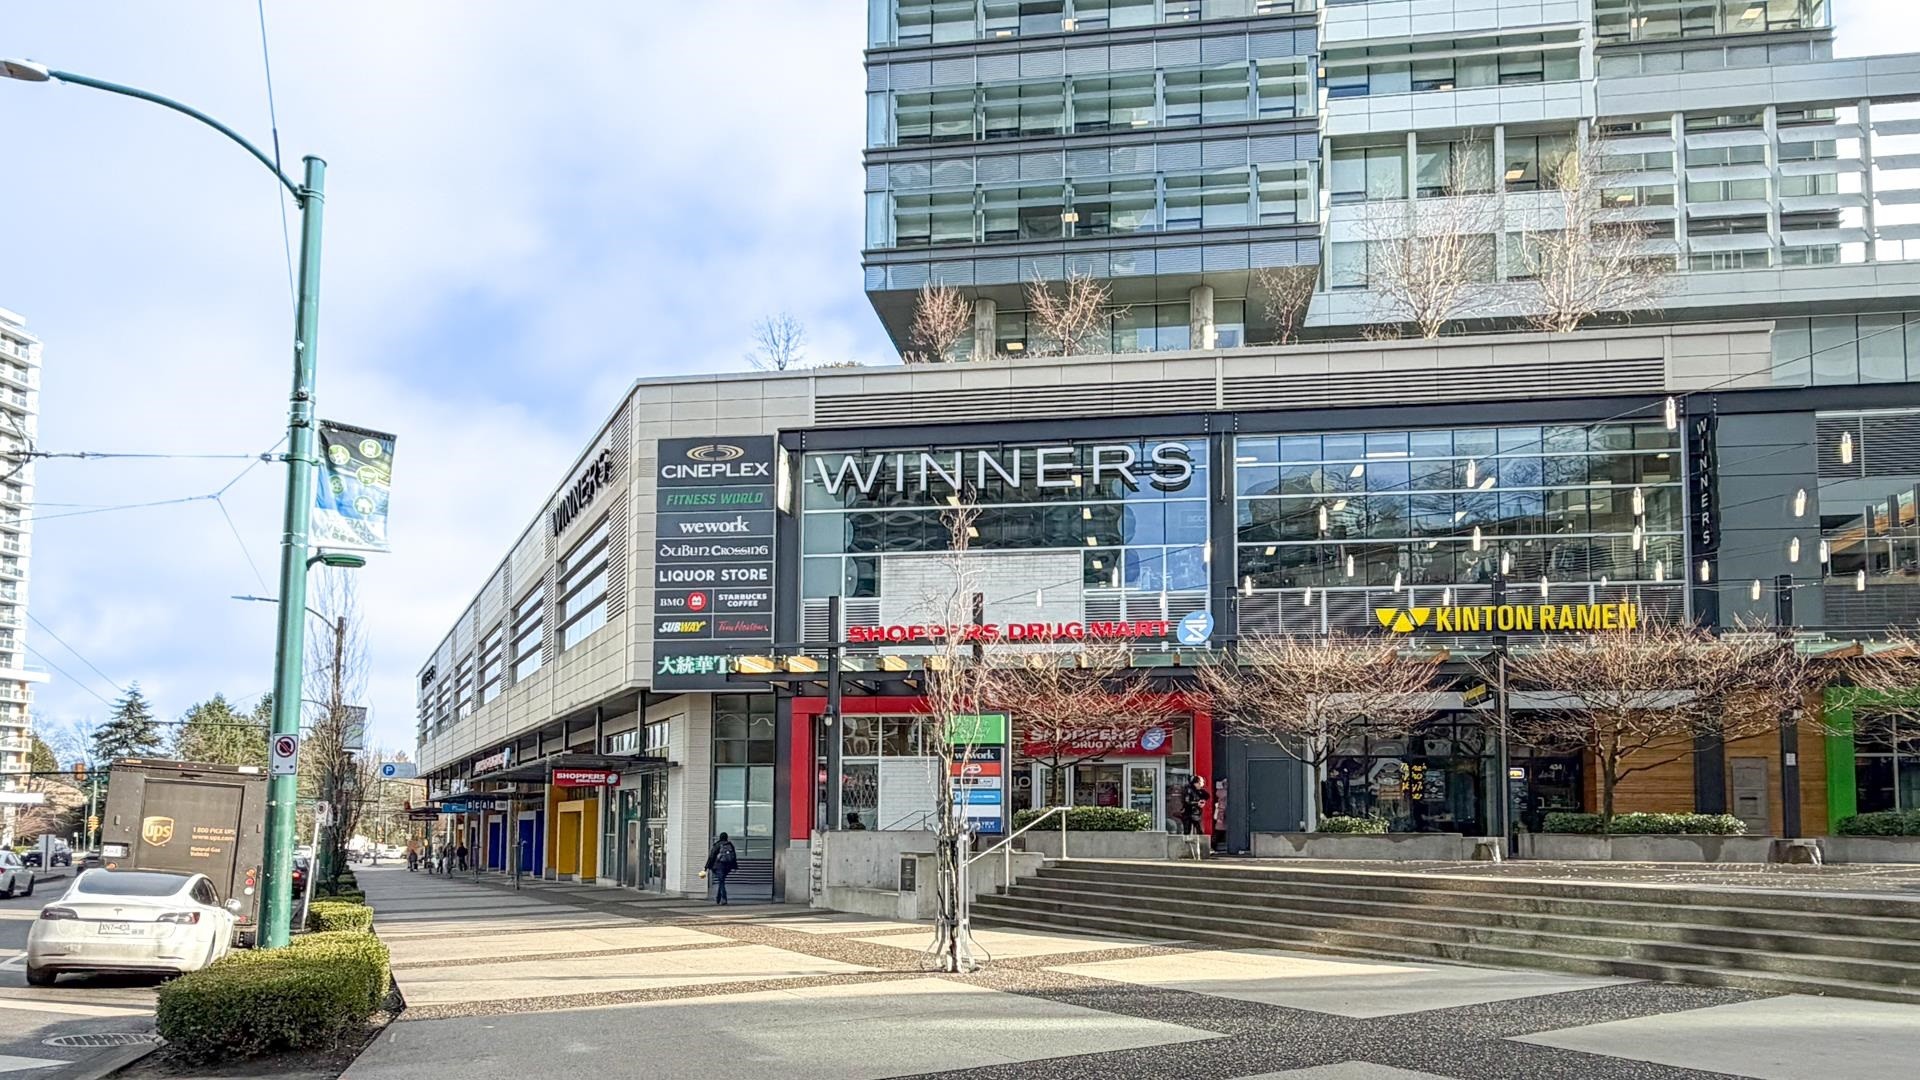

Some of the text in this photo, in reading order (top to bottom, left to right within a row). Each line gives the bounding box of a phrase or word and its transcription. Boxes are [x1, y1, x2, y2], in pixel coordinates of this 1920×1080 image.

[661, 462, 769, 478] CINEPLEX
[814, 442, 1192, 495] WINNERS
[1697, 418, 1711, 545] WINNERS
[553, 448, 612, 537] WINNERS
[666, 492, 764, 506] FITNESS WORLD
[679, 515, 750, 533] wework
[659, 568, 768, 582] LIQUOR STORE
[660, 598, 685, 606] BMO
[718, 593, 767, 601] STARBUCKS
[1436, 603, 1636, 632] KINTON RAMEN
[658, 621, 706, 633] SUBWAY
[719, 620, 769, 632] Tim Hortons
[1008, 620, 1084, 641] DRUG
[1090, 619, 1172, 638] MART
[657, 656, 714, 675] 大統華
[1030, 727, 1138, 741] SHOPPERS
[1072, 741, 1104, 749] DRUG
[145, 824, 171, 841] ups
